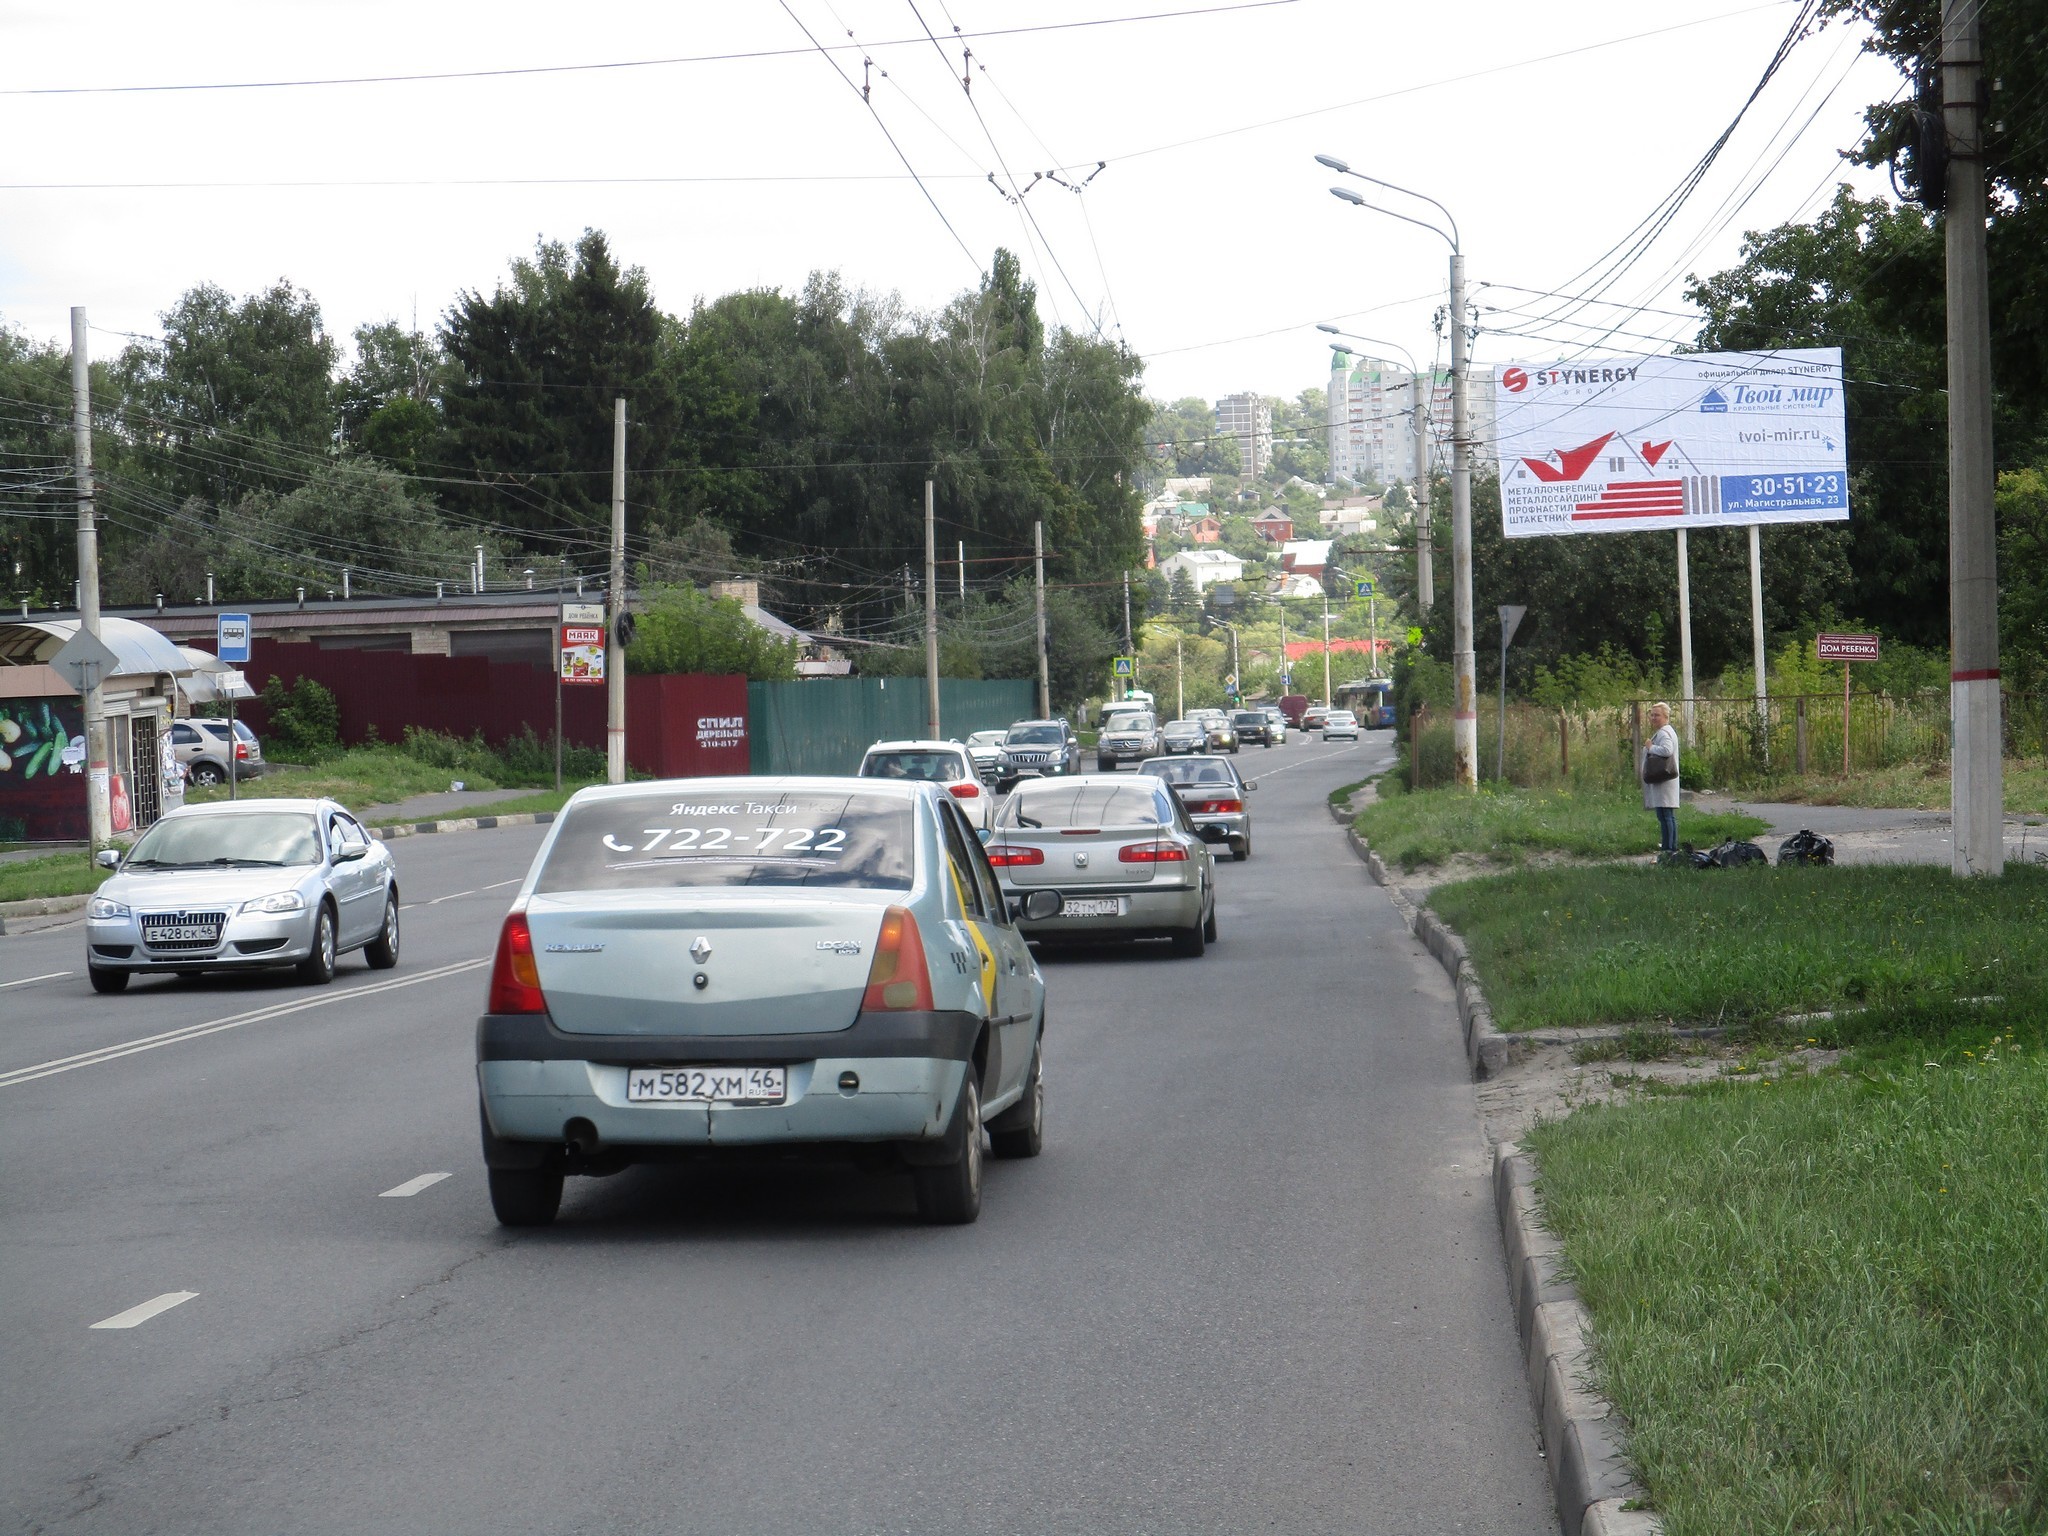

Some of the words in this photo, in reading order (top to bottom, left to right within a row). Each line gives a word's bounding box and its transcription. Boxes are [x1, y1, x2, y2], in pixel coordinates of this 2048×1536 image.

[1537, 367, 1638, 386] STYNERGY
[1734, 384, 1782, 404] Твой
[1787, 386, 1834, 408] мир
[1739, 428, 1820, 443] tvoi-mir.ru
[1508, 483, 1605, 496] МЕТАЛЛОЧЕРЕПИЦА
[1508, 493, 1599, 505] МЕТАЛЛОСАЙДИНГ
[1728, 501, 1742, 511] ул.
[1745, 496, 1825, 508] Магистральная,
[1827, 495, 1839, 504] 23
[1509, 504, 1574, 514] ПРОФНАСТИЛ
[1509, 514, 1569, 524] ШТАКЕТНИК
[1820, 644, 1840, 653] ДОМ
[1841, 645, 1876, 654] РЕБЕНКА
[697, 717, 743, 729] СПИЛ
[701, 740, 739, 748] 310-817
[670, 802, 740, 816] Яндекс
[745, 802, 799, 815] Такси
[641, 827, 847, 852] 722-722
[816, 940, 861, 950] LOGAN
